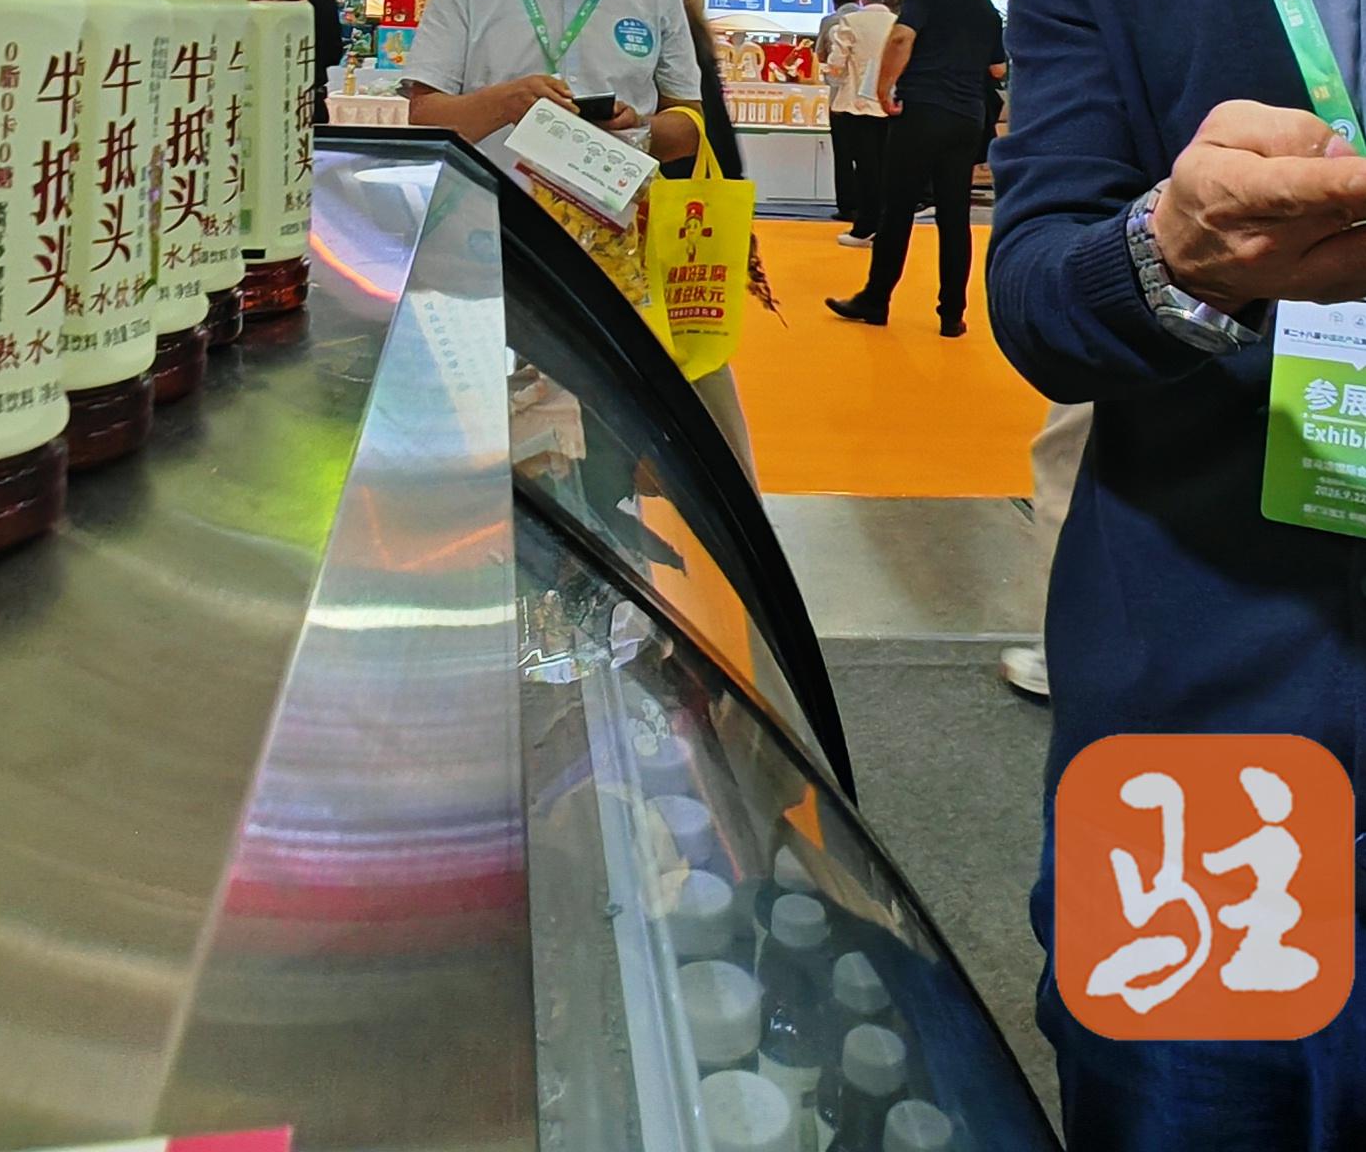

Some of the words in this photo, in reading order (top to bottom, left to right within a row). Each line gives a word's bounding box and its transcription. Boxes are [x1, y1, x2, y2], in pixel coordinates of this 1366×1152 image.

[89, 43, 142, 273] 牛抵头
[163, 41, 211, 234] 牛抵头
